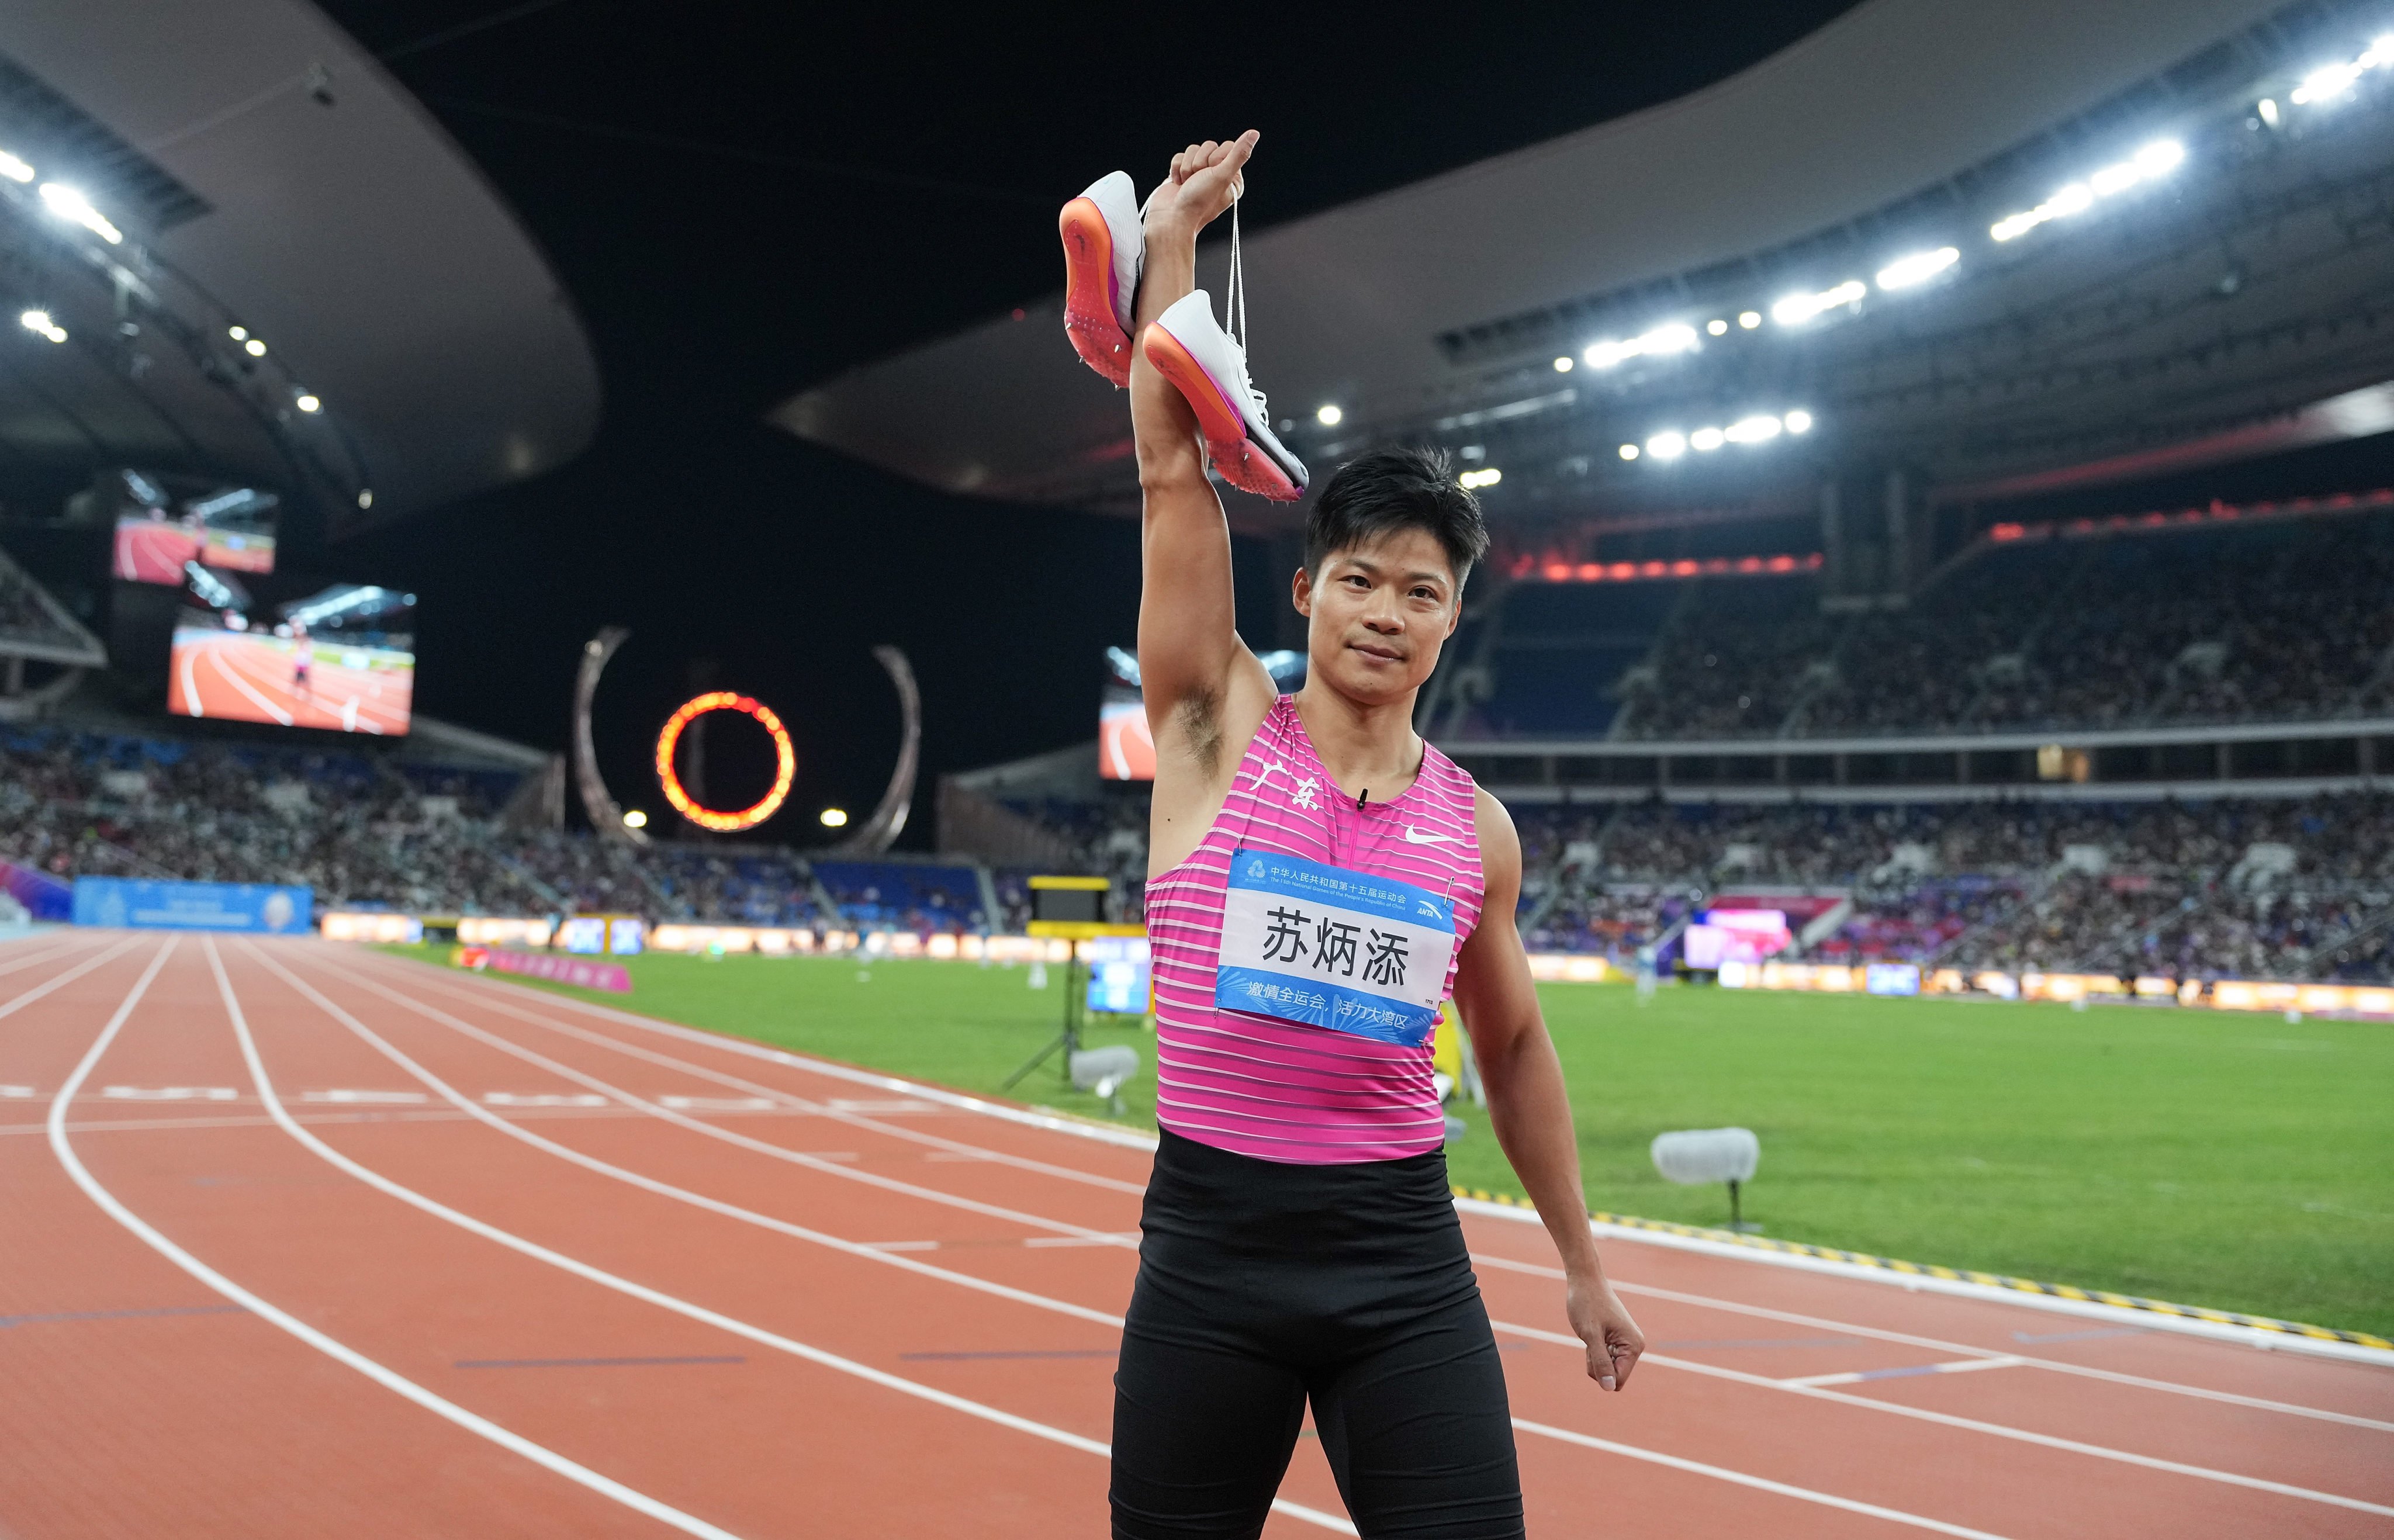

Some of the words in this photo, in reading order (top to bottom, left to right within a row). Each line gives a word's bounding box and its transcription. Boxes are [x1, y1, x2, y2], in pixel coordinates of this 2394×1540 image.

[1248, 759, 1320, 811] 广东
[1271, 866, 1407, 904] 中华人民共和国第十五届运动会
[1292, 881, 1312, 890] National
[1344, 893, 1365, 901] People's
[1365, 897, 1386, 906] Republic
[1392, 903, 1406, 911] China
[1417, 907, 1434, 918] ANTA
[1262, 906, 1409, 986] 苏炳添
